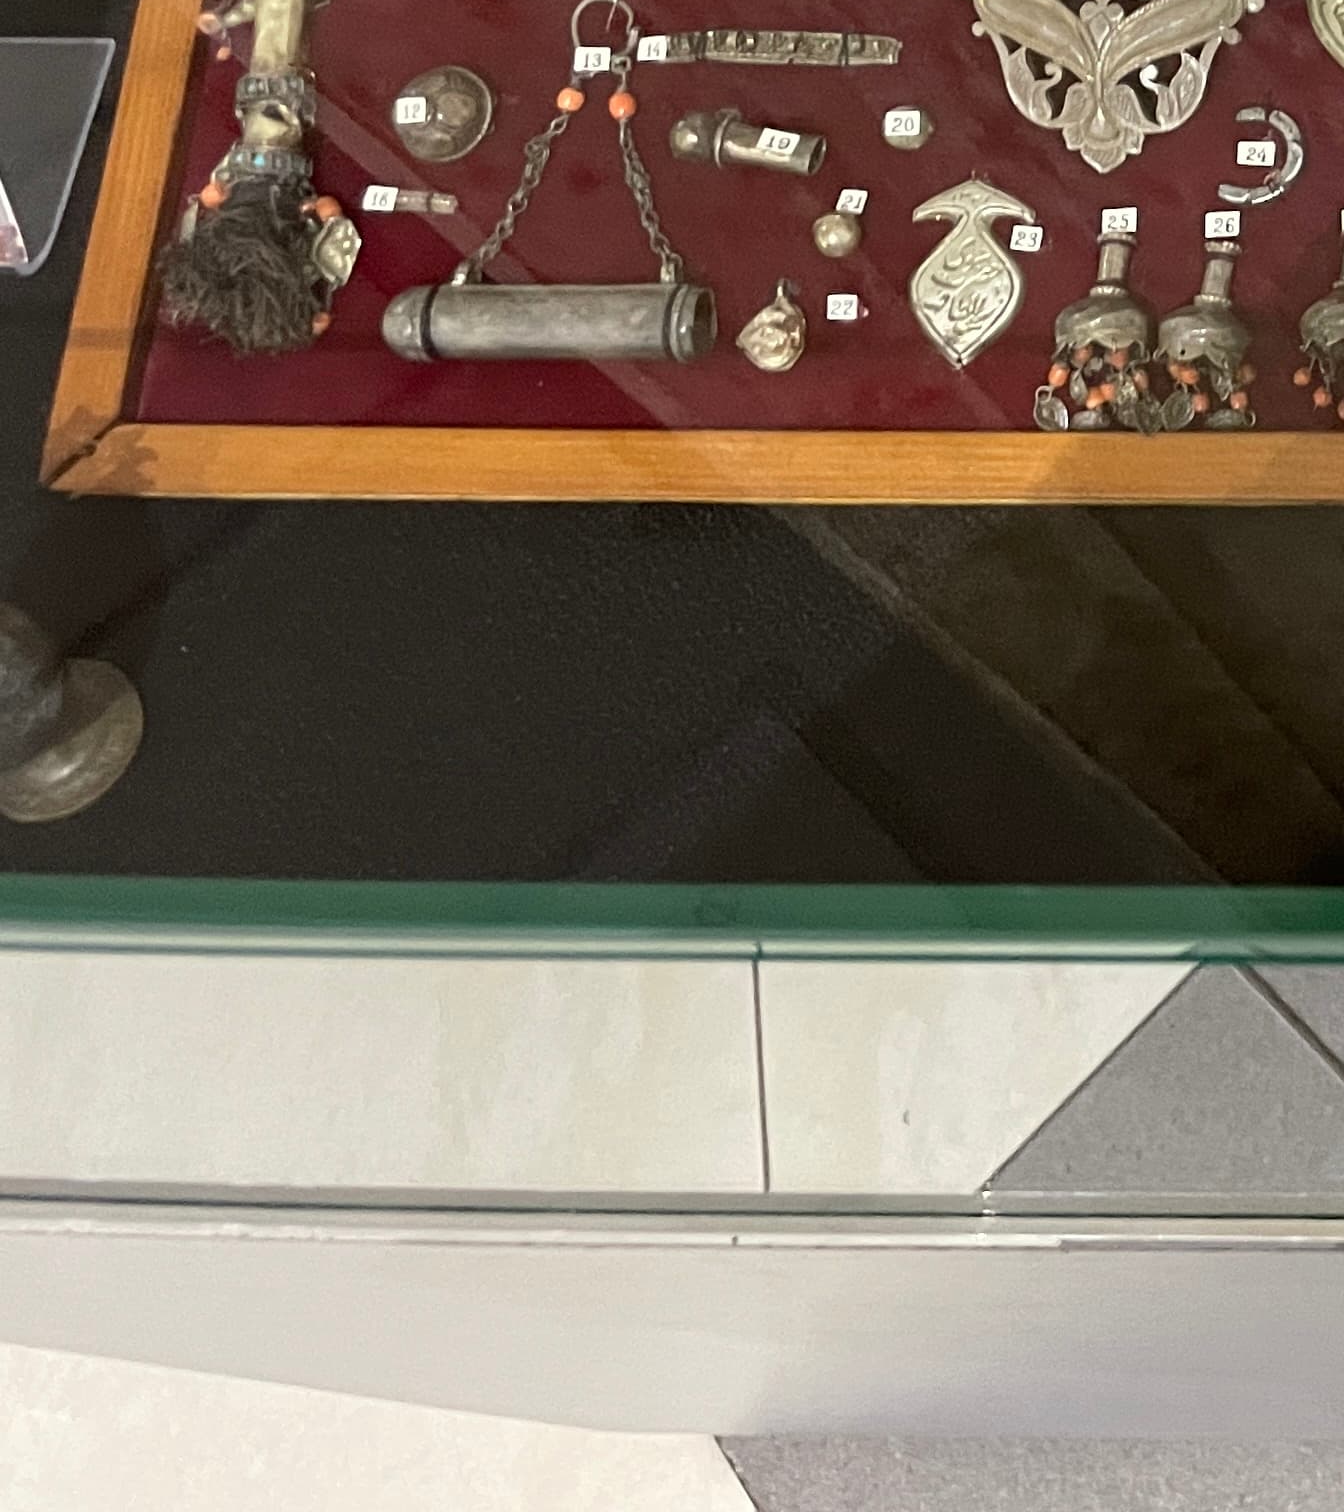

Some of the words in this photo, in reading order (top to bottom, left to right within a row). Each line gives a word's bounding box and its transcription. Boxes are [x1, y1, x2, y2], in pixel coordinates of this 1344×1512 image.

[647, 44, 660, 57] 14
[583, 53, 602, 68] 13
[405, 105, 420, 119] 12
[891, 117, 914, 133] 20
[1246, 147, 1266, 163] 24
[841, 195, 862, 210] 21
[1108, 214, 1129, 231] 25
[1213, 217, 1235, 233] 26
[1016, 232, 1038, 247] 23
[830, 300, 853, 315] 22
